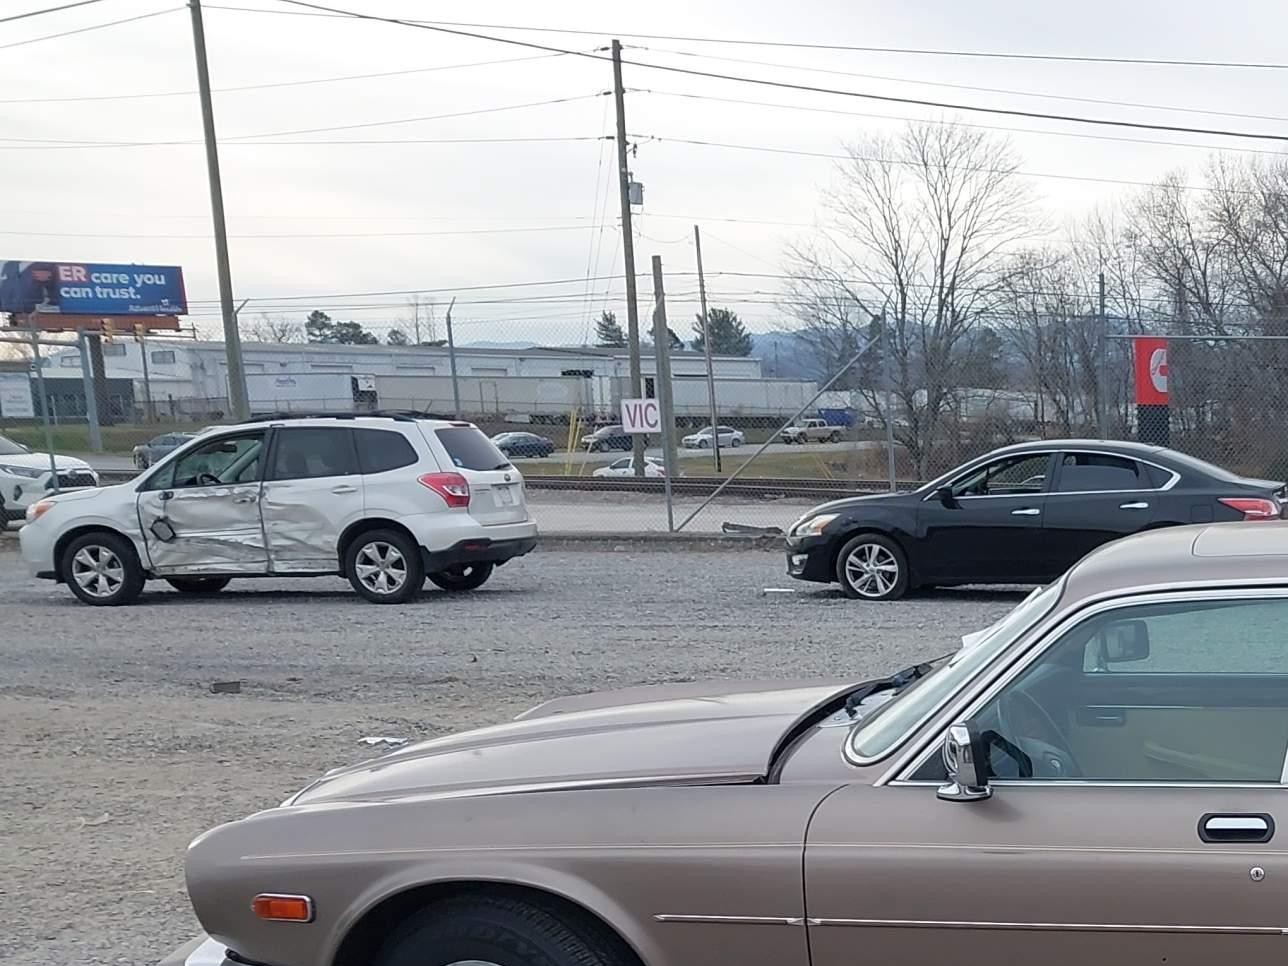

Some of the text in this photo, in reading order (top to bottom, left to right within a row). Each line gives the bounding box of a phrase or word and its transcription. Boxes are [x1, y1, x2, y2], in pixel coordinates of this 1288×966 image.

[57, 265, 166, 287] ER care you
[60, 286, 142, 300] can trust.
[625, 402, 659, 429] VIC
